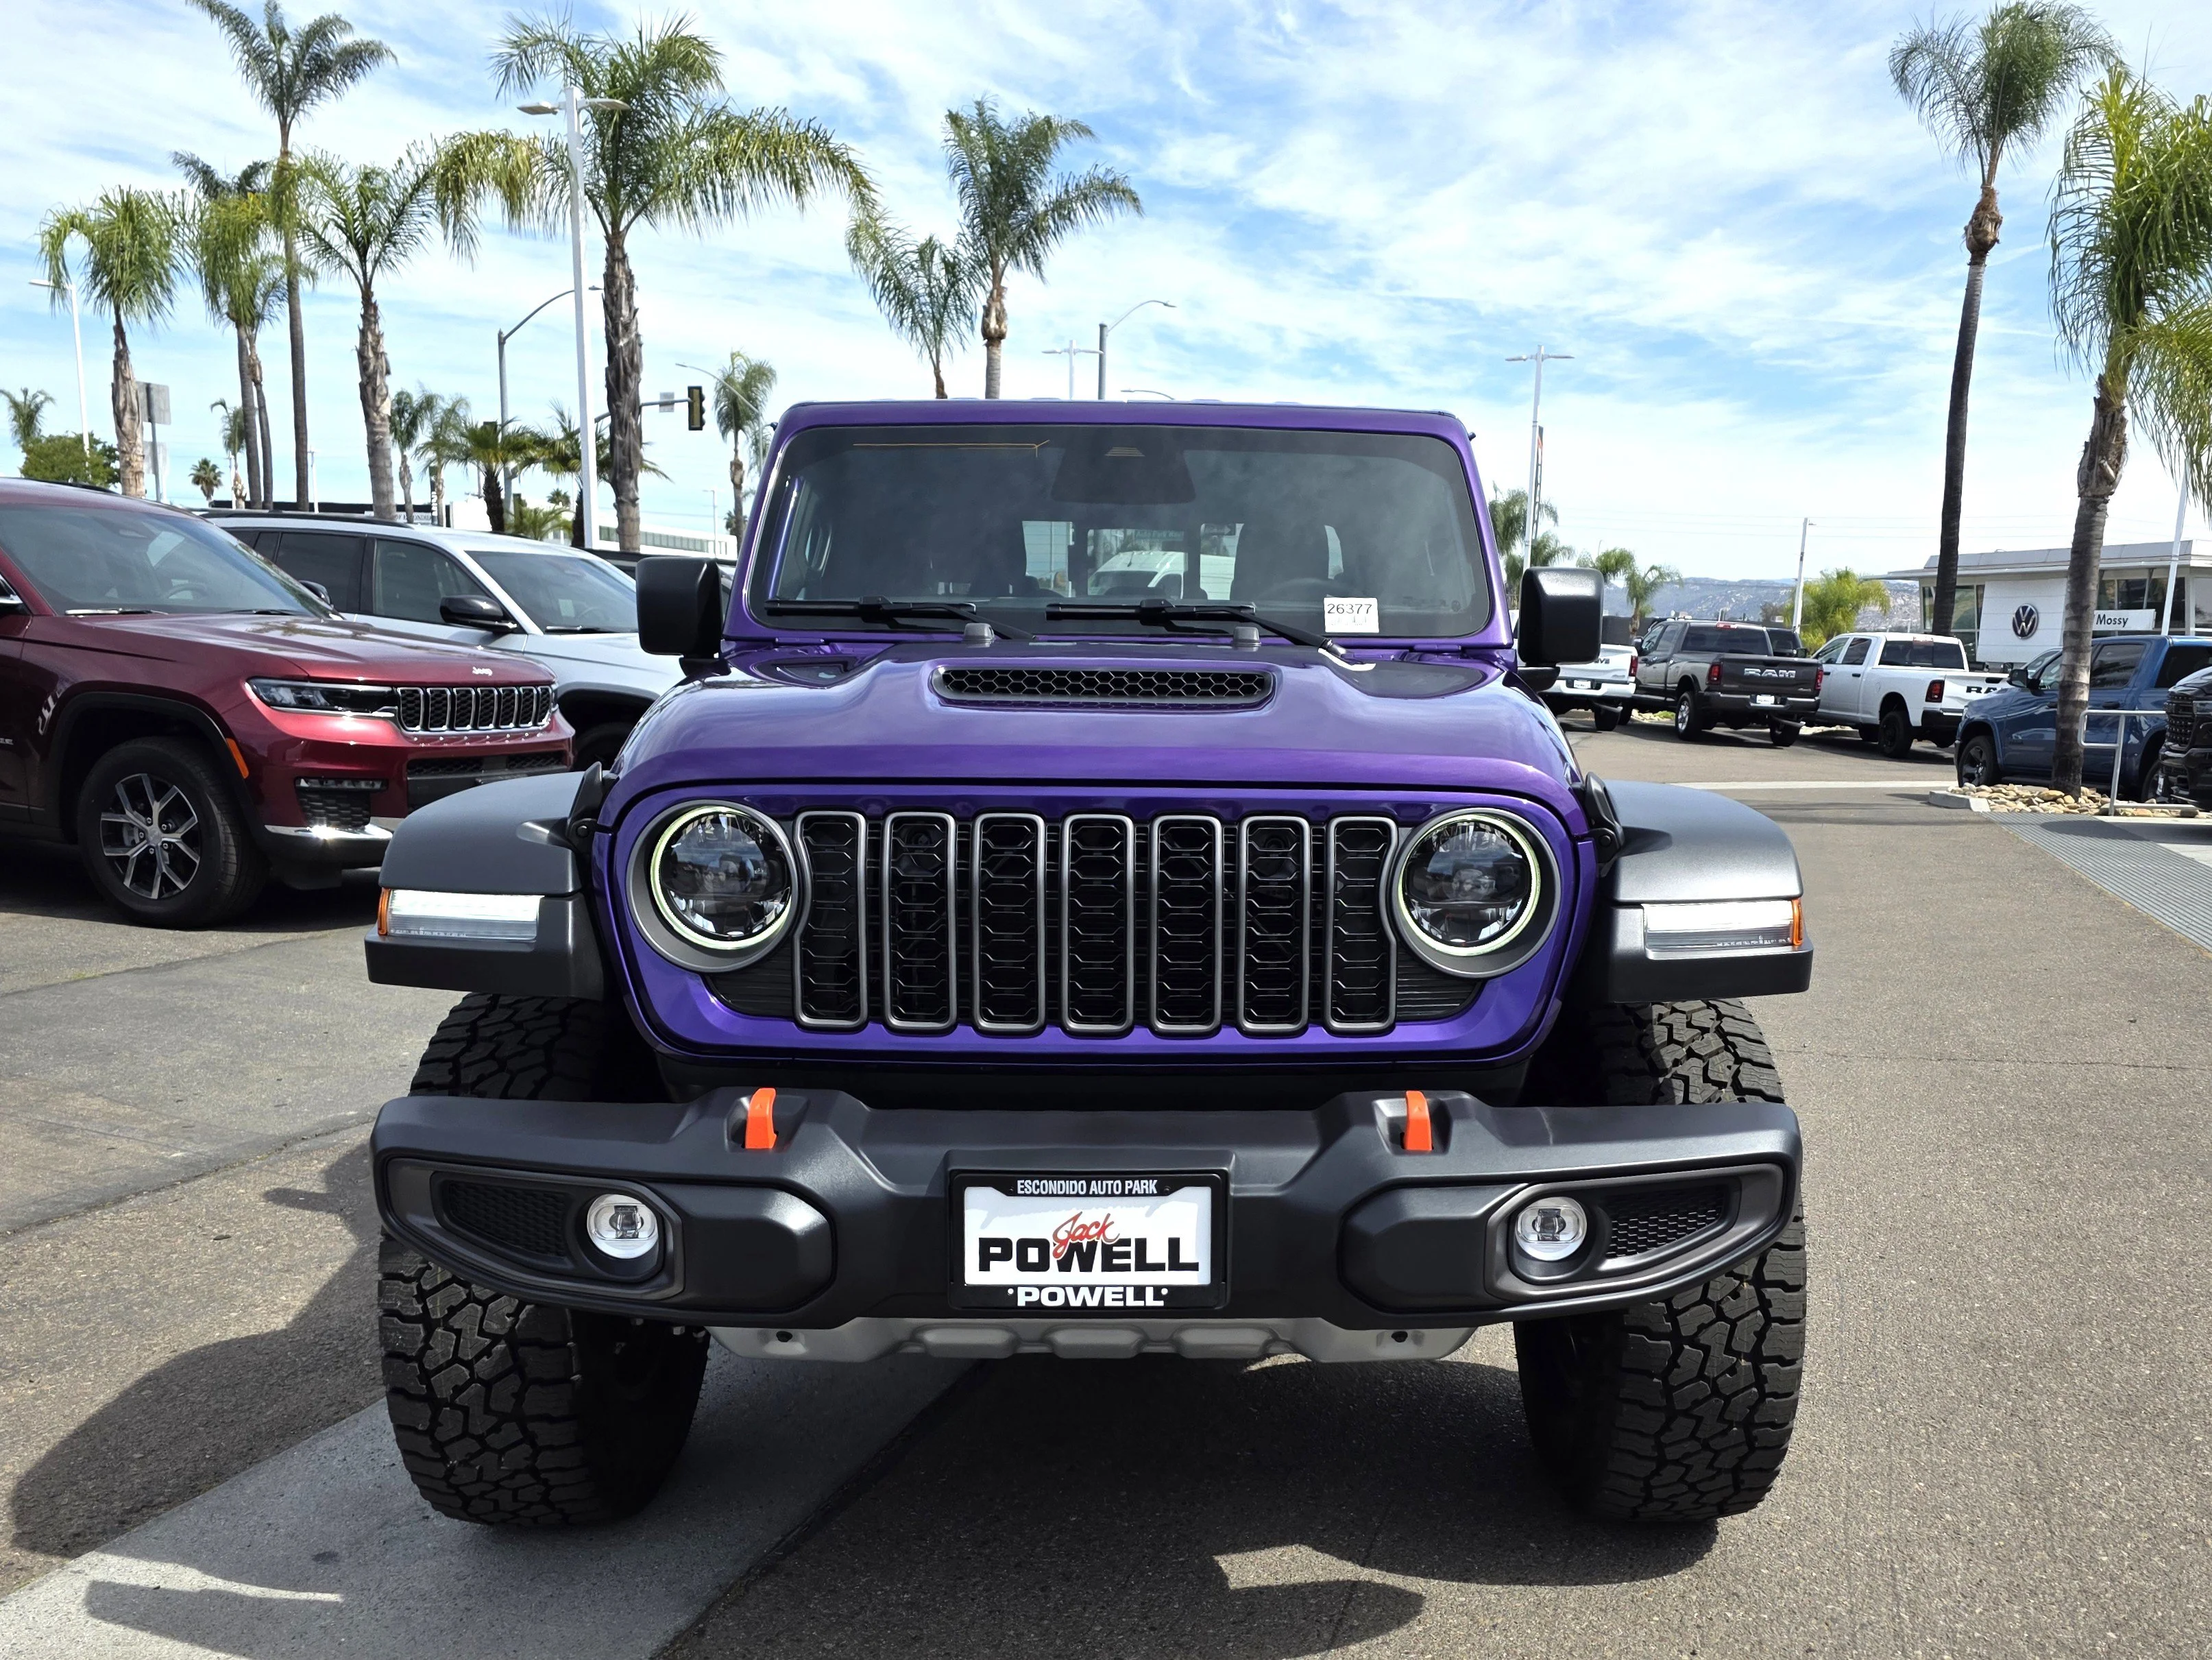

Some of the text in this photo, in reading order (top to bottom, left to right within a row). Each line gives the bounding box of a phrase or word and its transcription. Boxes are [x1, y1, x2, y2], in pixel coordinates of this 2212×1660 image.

[1327, 603, 1372, 614] 26377
[2095, 614, 2129, 628] Mossy
[1743, 668, 1796, 678] RAM
[1965, 686, 1998, 694] RA
[1017, 1179, 1158, 1195] ESCONDIDO AUTO PARK
[1052, 1211, 1121, 1260] Jack
[978, 1237, 1200, 1273] POWELL
[1017, 1286, 1165, 1307] POWELL
